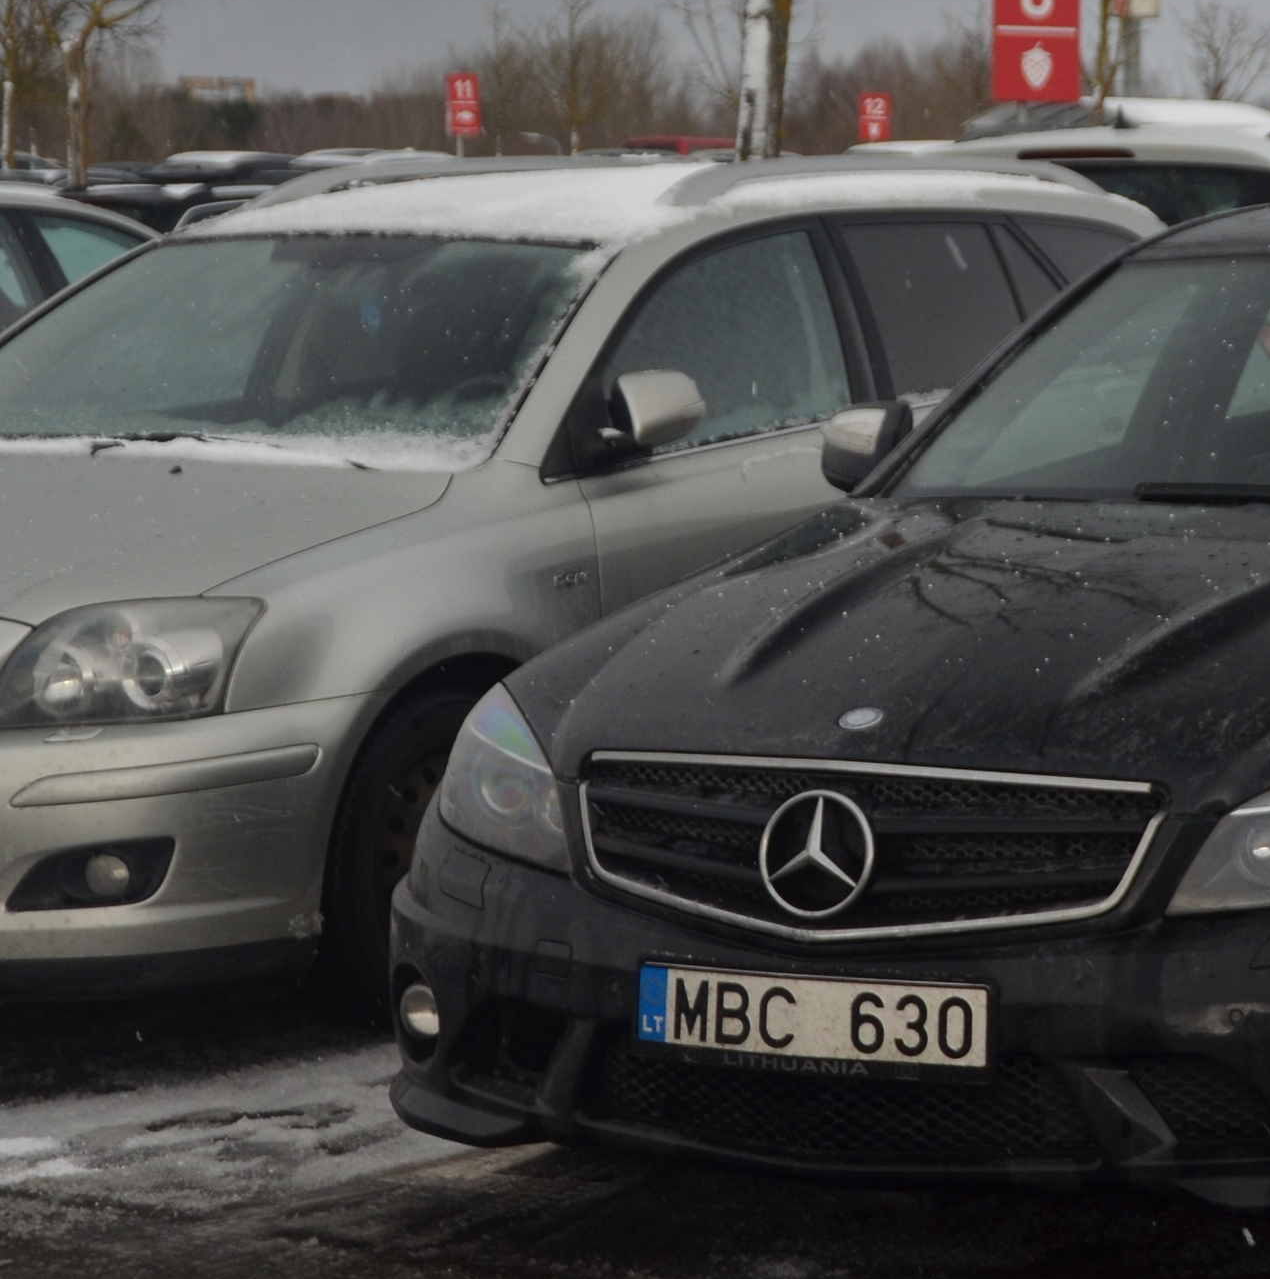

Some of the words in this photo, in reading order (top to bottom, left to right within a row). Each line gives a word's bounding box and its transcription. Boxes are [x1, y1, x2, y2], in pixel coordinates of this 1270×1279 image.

[454, 79, 475, 100] 11
[863, 97, 887, 115] 12
[642, 1014, 664, 1032] LT
[673, 977, 796, 1049] MBC
[850, 991, 973, 1059] 630
[722, 1052, 870, 1075] LITHUANIA
